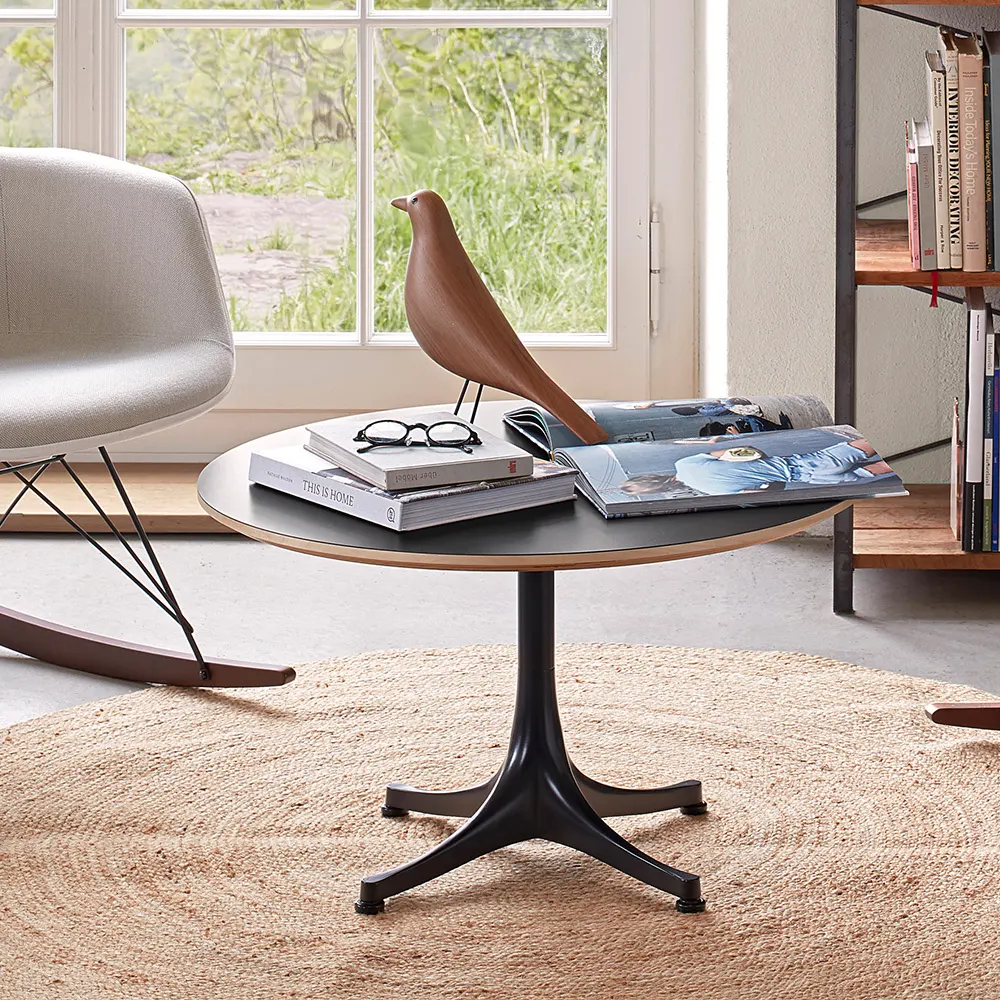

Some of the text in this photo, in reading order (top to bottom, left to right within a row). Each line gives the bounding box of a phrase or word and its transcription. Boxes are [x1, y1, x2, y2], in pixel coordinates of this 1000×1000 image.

[948, 87, 960, 244] INTERIOR DECORATING
[963, 87, 977, 195] Inside Today's Home
[303, 479, 354, 507] THIS IS HOME
